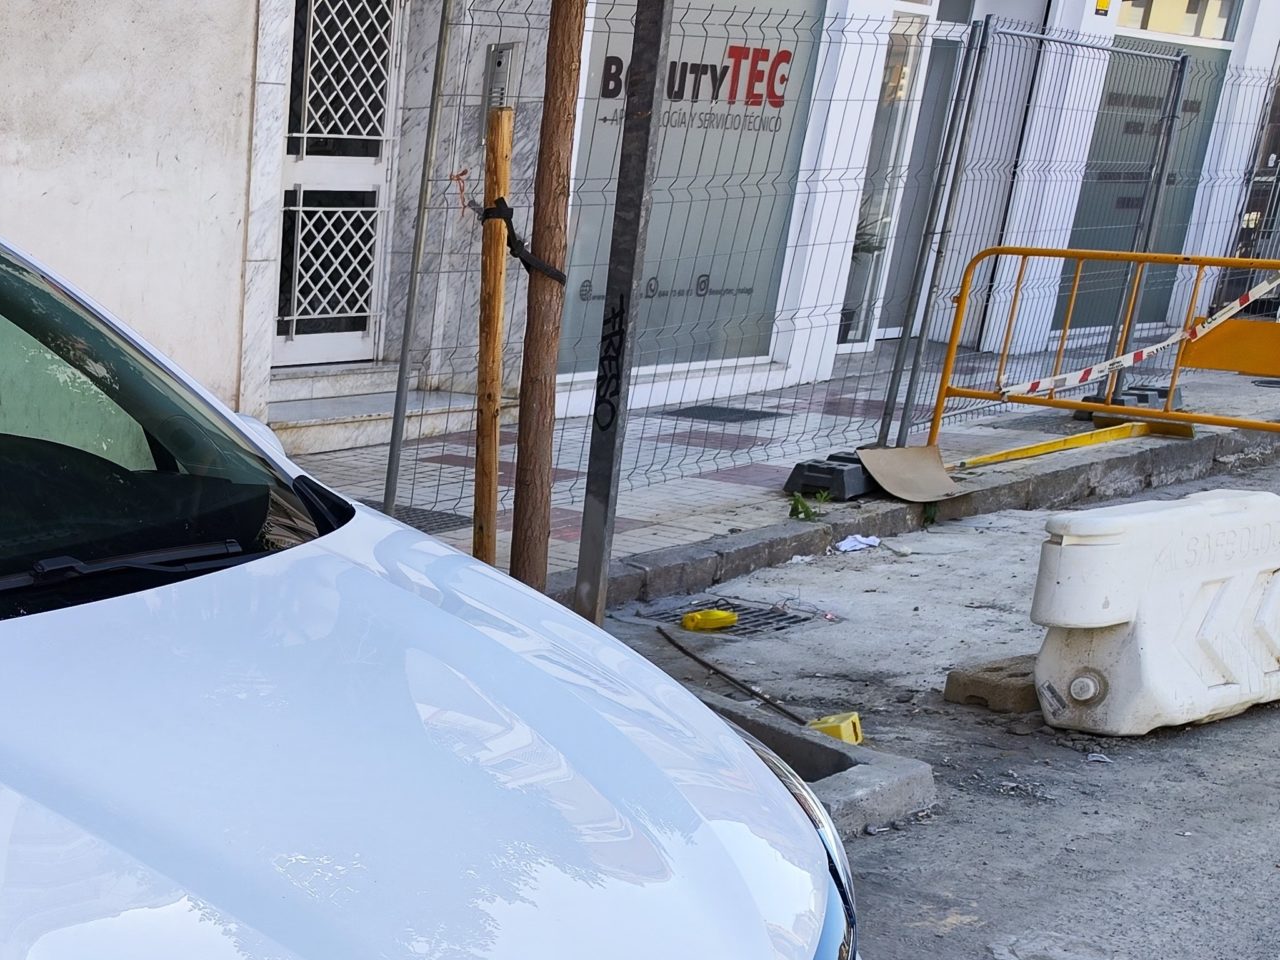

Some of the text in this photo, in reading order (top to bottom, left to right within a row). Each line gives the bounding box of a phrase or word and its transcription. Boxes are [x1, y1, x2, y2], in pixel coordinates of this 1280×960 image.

[601, 45, 793, 109] BUTYTEC
[690, 111, 699, 129] Y
[698, 111, 744, 131] SERVICIO
[744, 111, 783, 133] TÉCNICO
